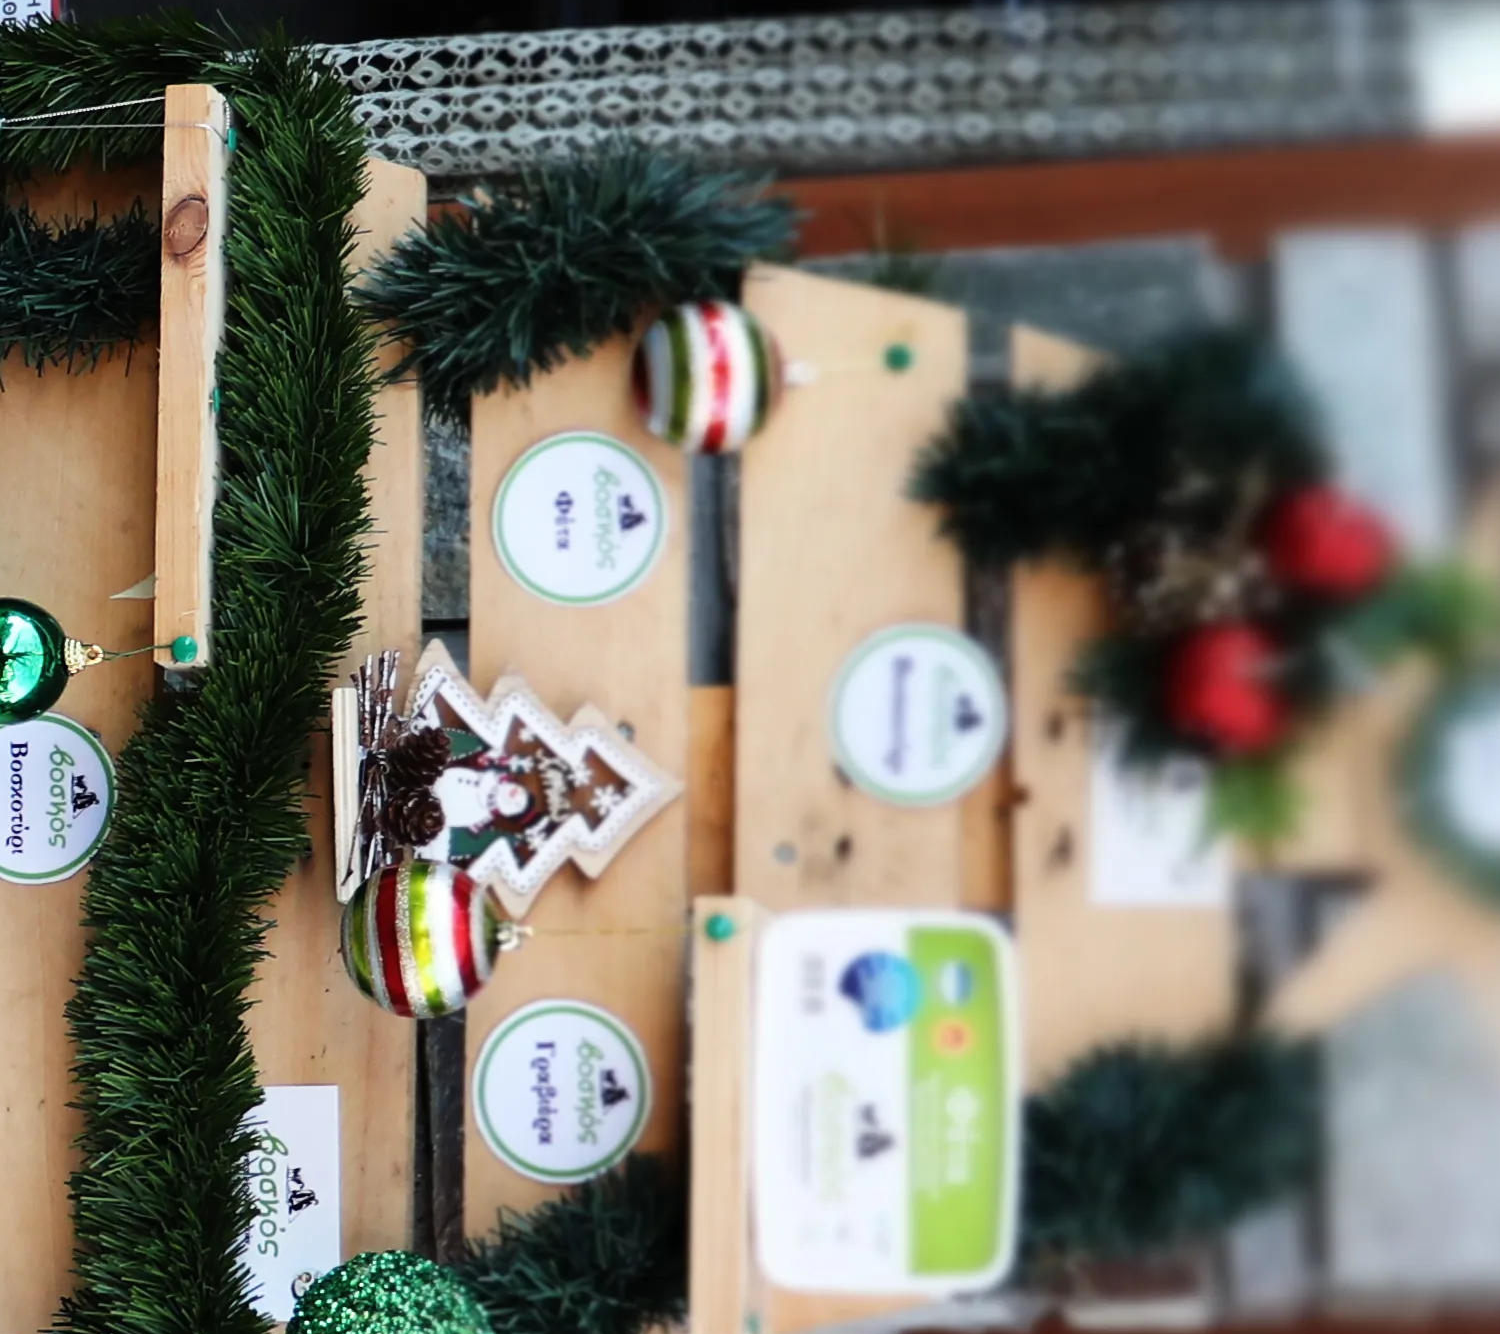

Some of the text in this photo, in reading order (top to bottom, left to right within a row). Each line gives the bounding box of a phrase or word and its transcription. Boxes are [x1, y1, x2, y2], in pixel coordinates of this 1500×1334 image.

[555, 491, 576, 550] Φέτα
[590, 465, 622, 571] βοσκός
[6, 742, 30, 854] Βοσκοτύρι
[45, 744, 75, 849] βοσκός
[530, 1041, 559, 1146] Γραβιέρα
[573, 1037, 604, 1147] βοσκός
[257, 1128, 289, 1258] βοσκός
